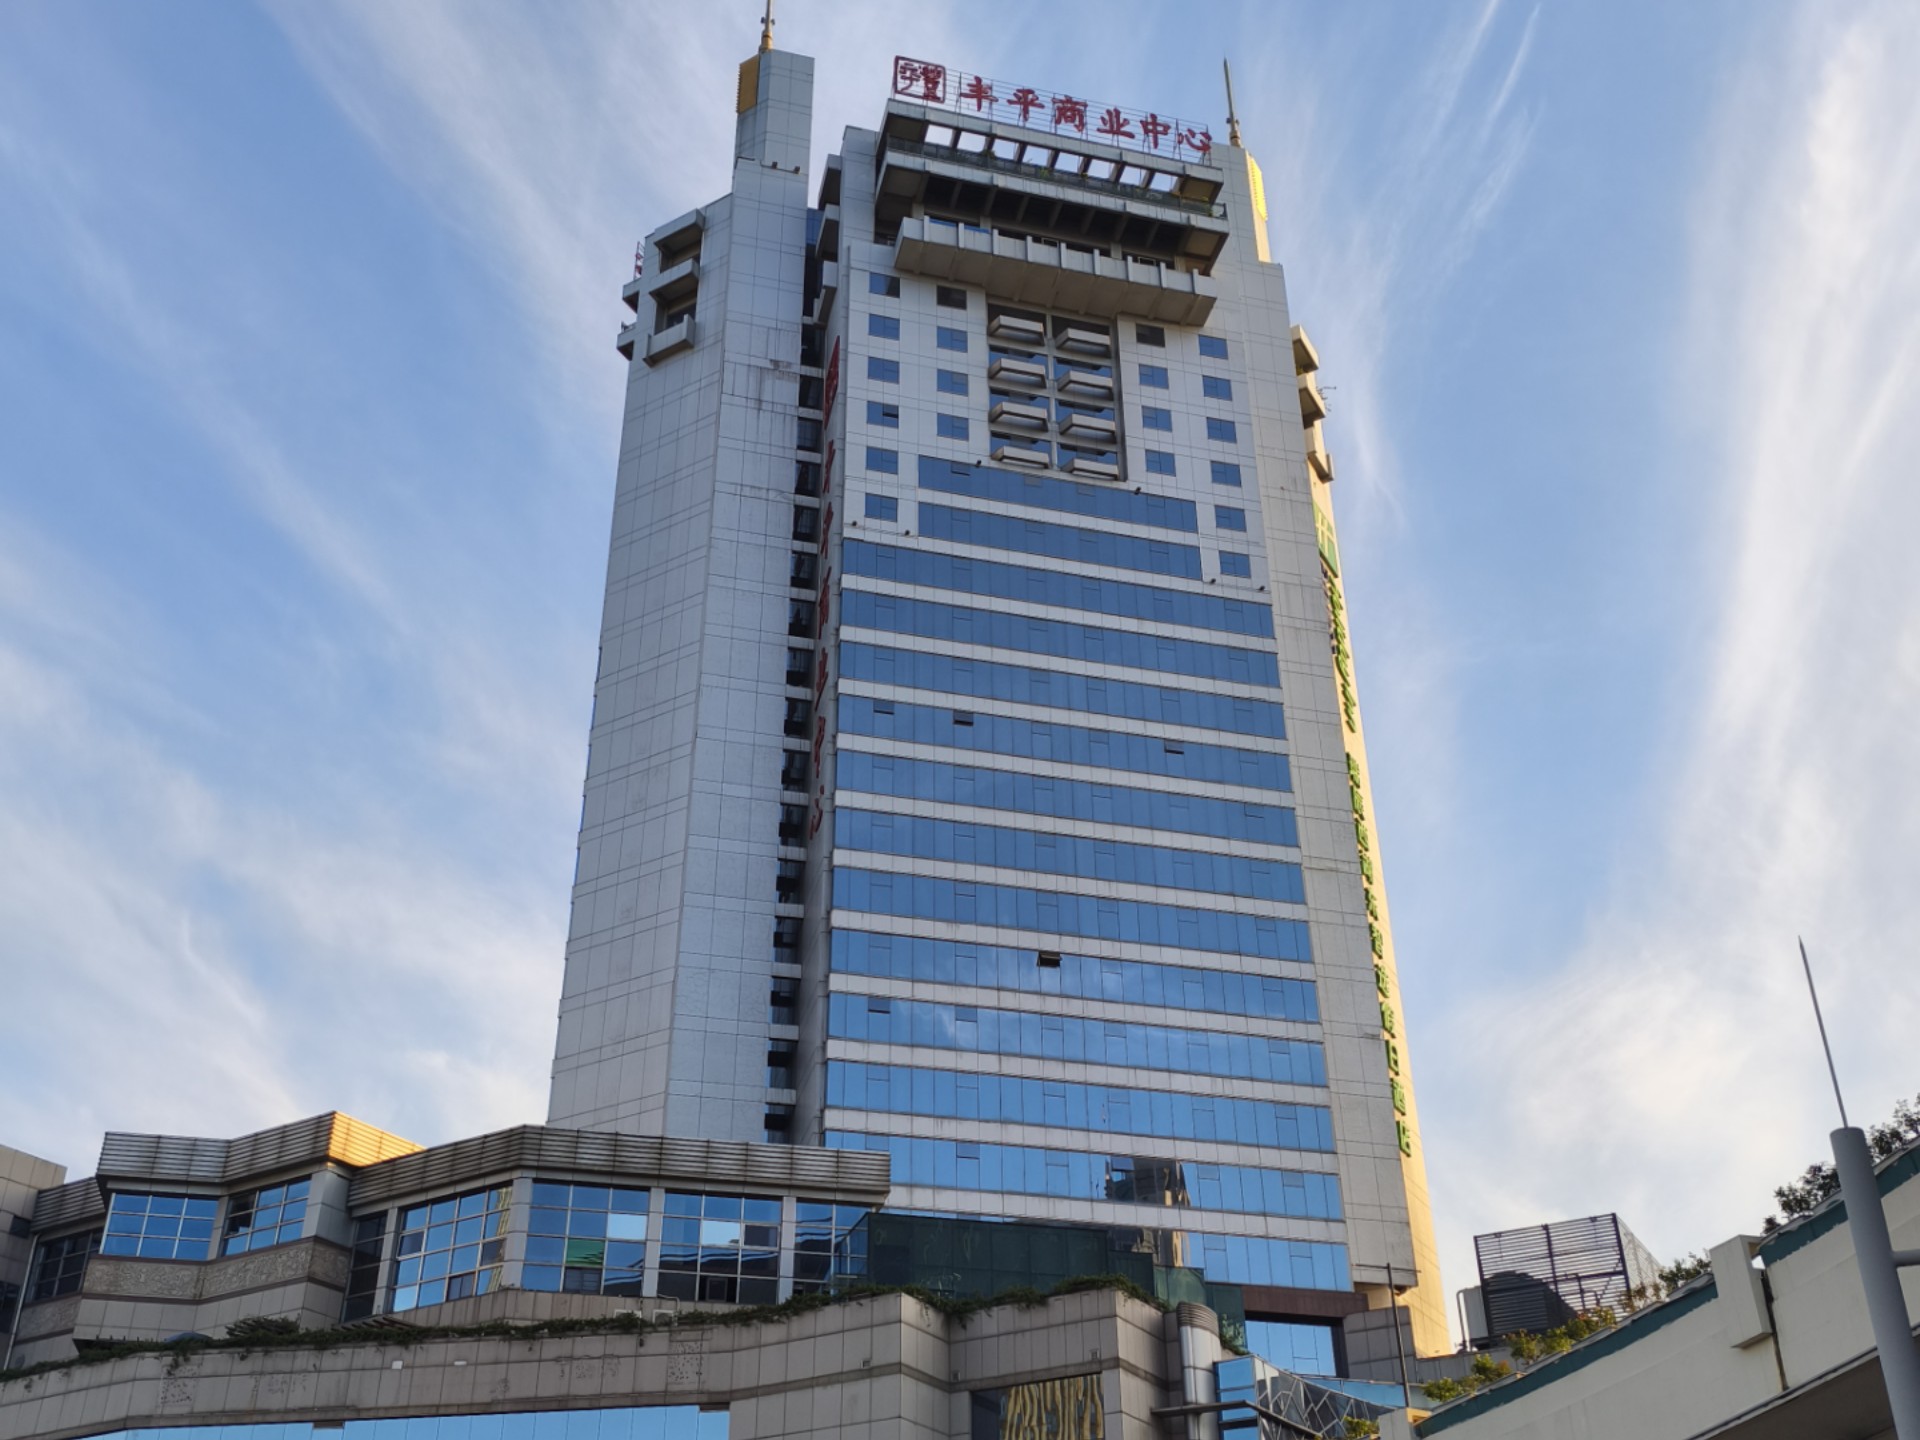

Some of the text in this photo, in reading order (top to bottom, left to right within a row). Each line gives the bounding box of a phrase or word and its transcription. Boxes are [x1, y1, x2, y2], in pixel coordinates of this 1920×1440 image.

[960, 75, 1212, 153] 丰平商业中心
